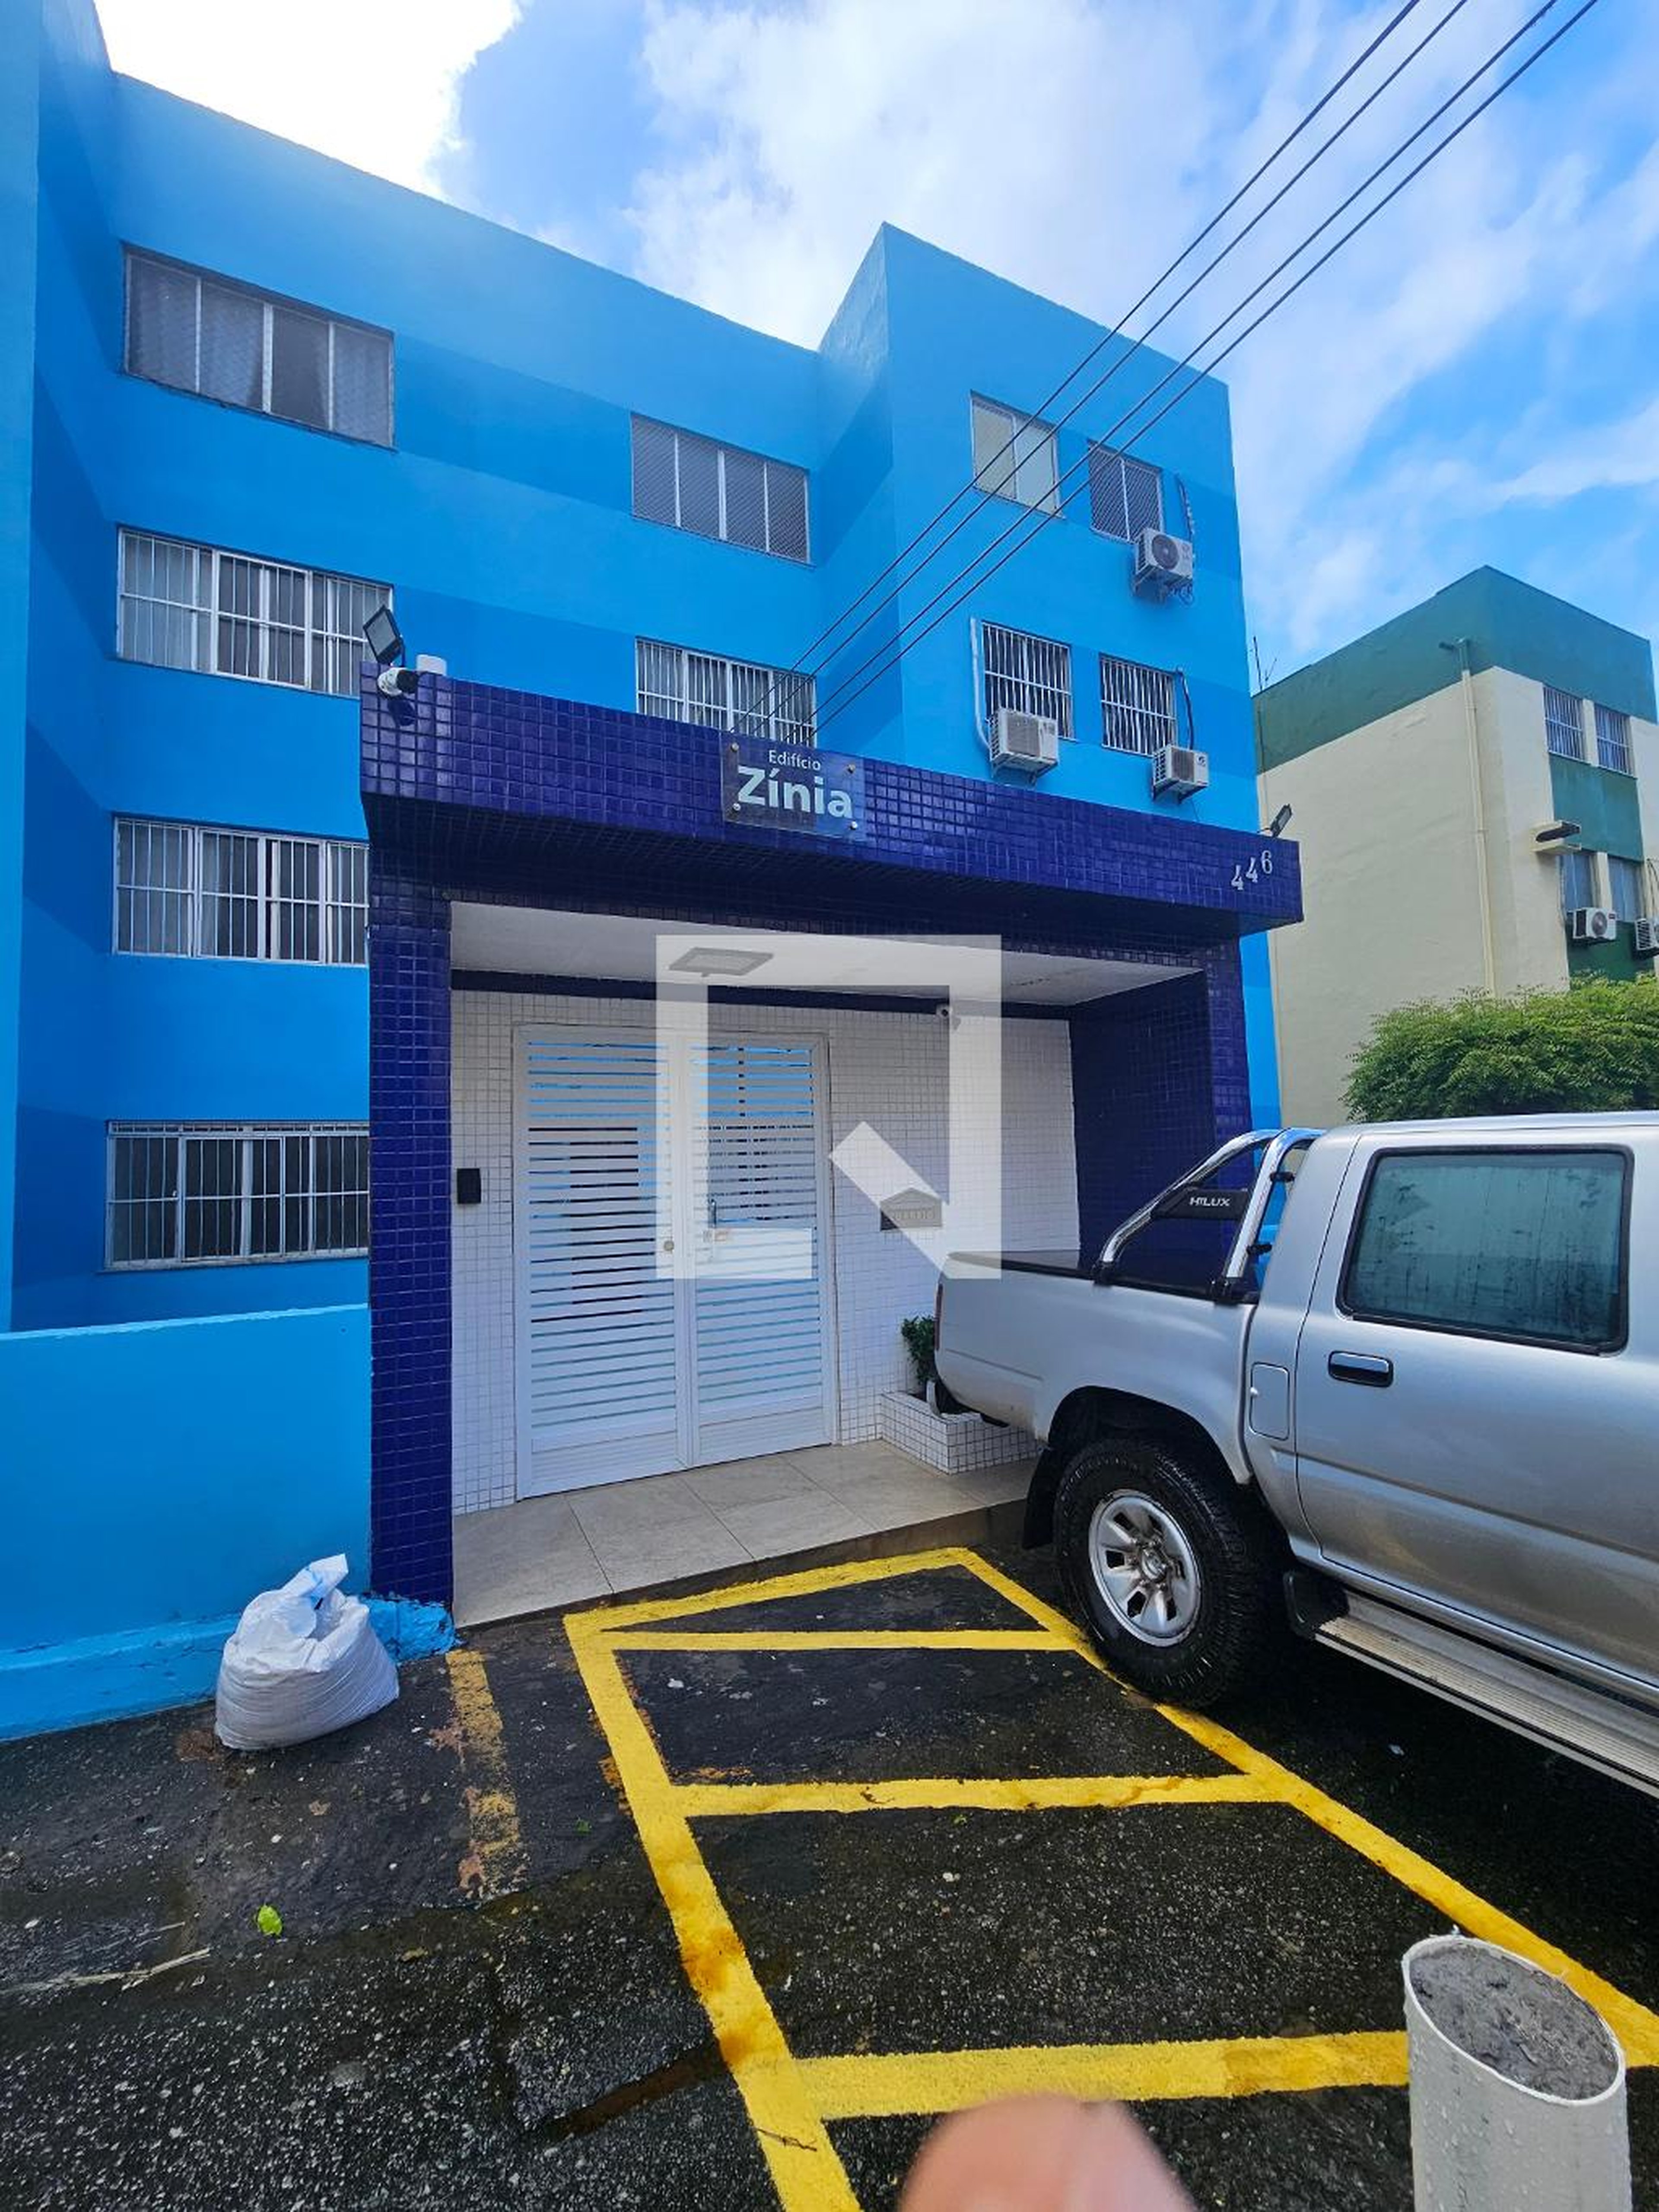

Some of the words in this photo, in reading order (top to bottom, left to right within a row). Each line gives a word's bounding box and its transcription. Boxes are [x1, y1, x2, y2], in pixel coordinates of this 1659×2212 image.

[738, 765, 852, 818] Zínia
[1231, 850, 1273, 890] 446
[1190, 1197, 1230, 1206] HILUX
